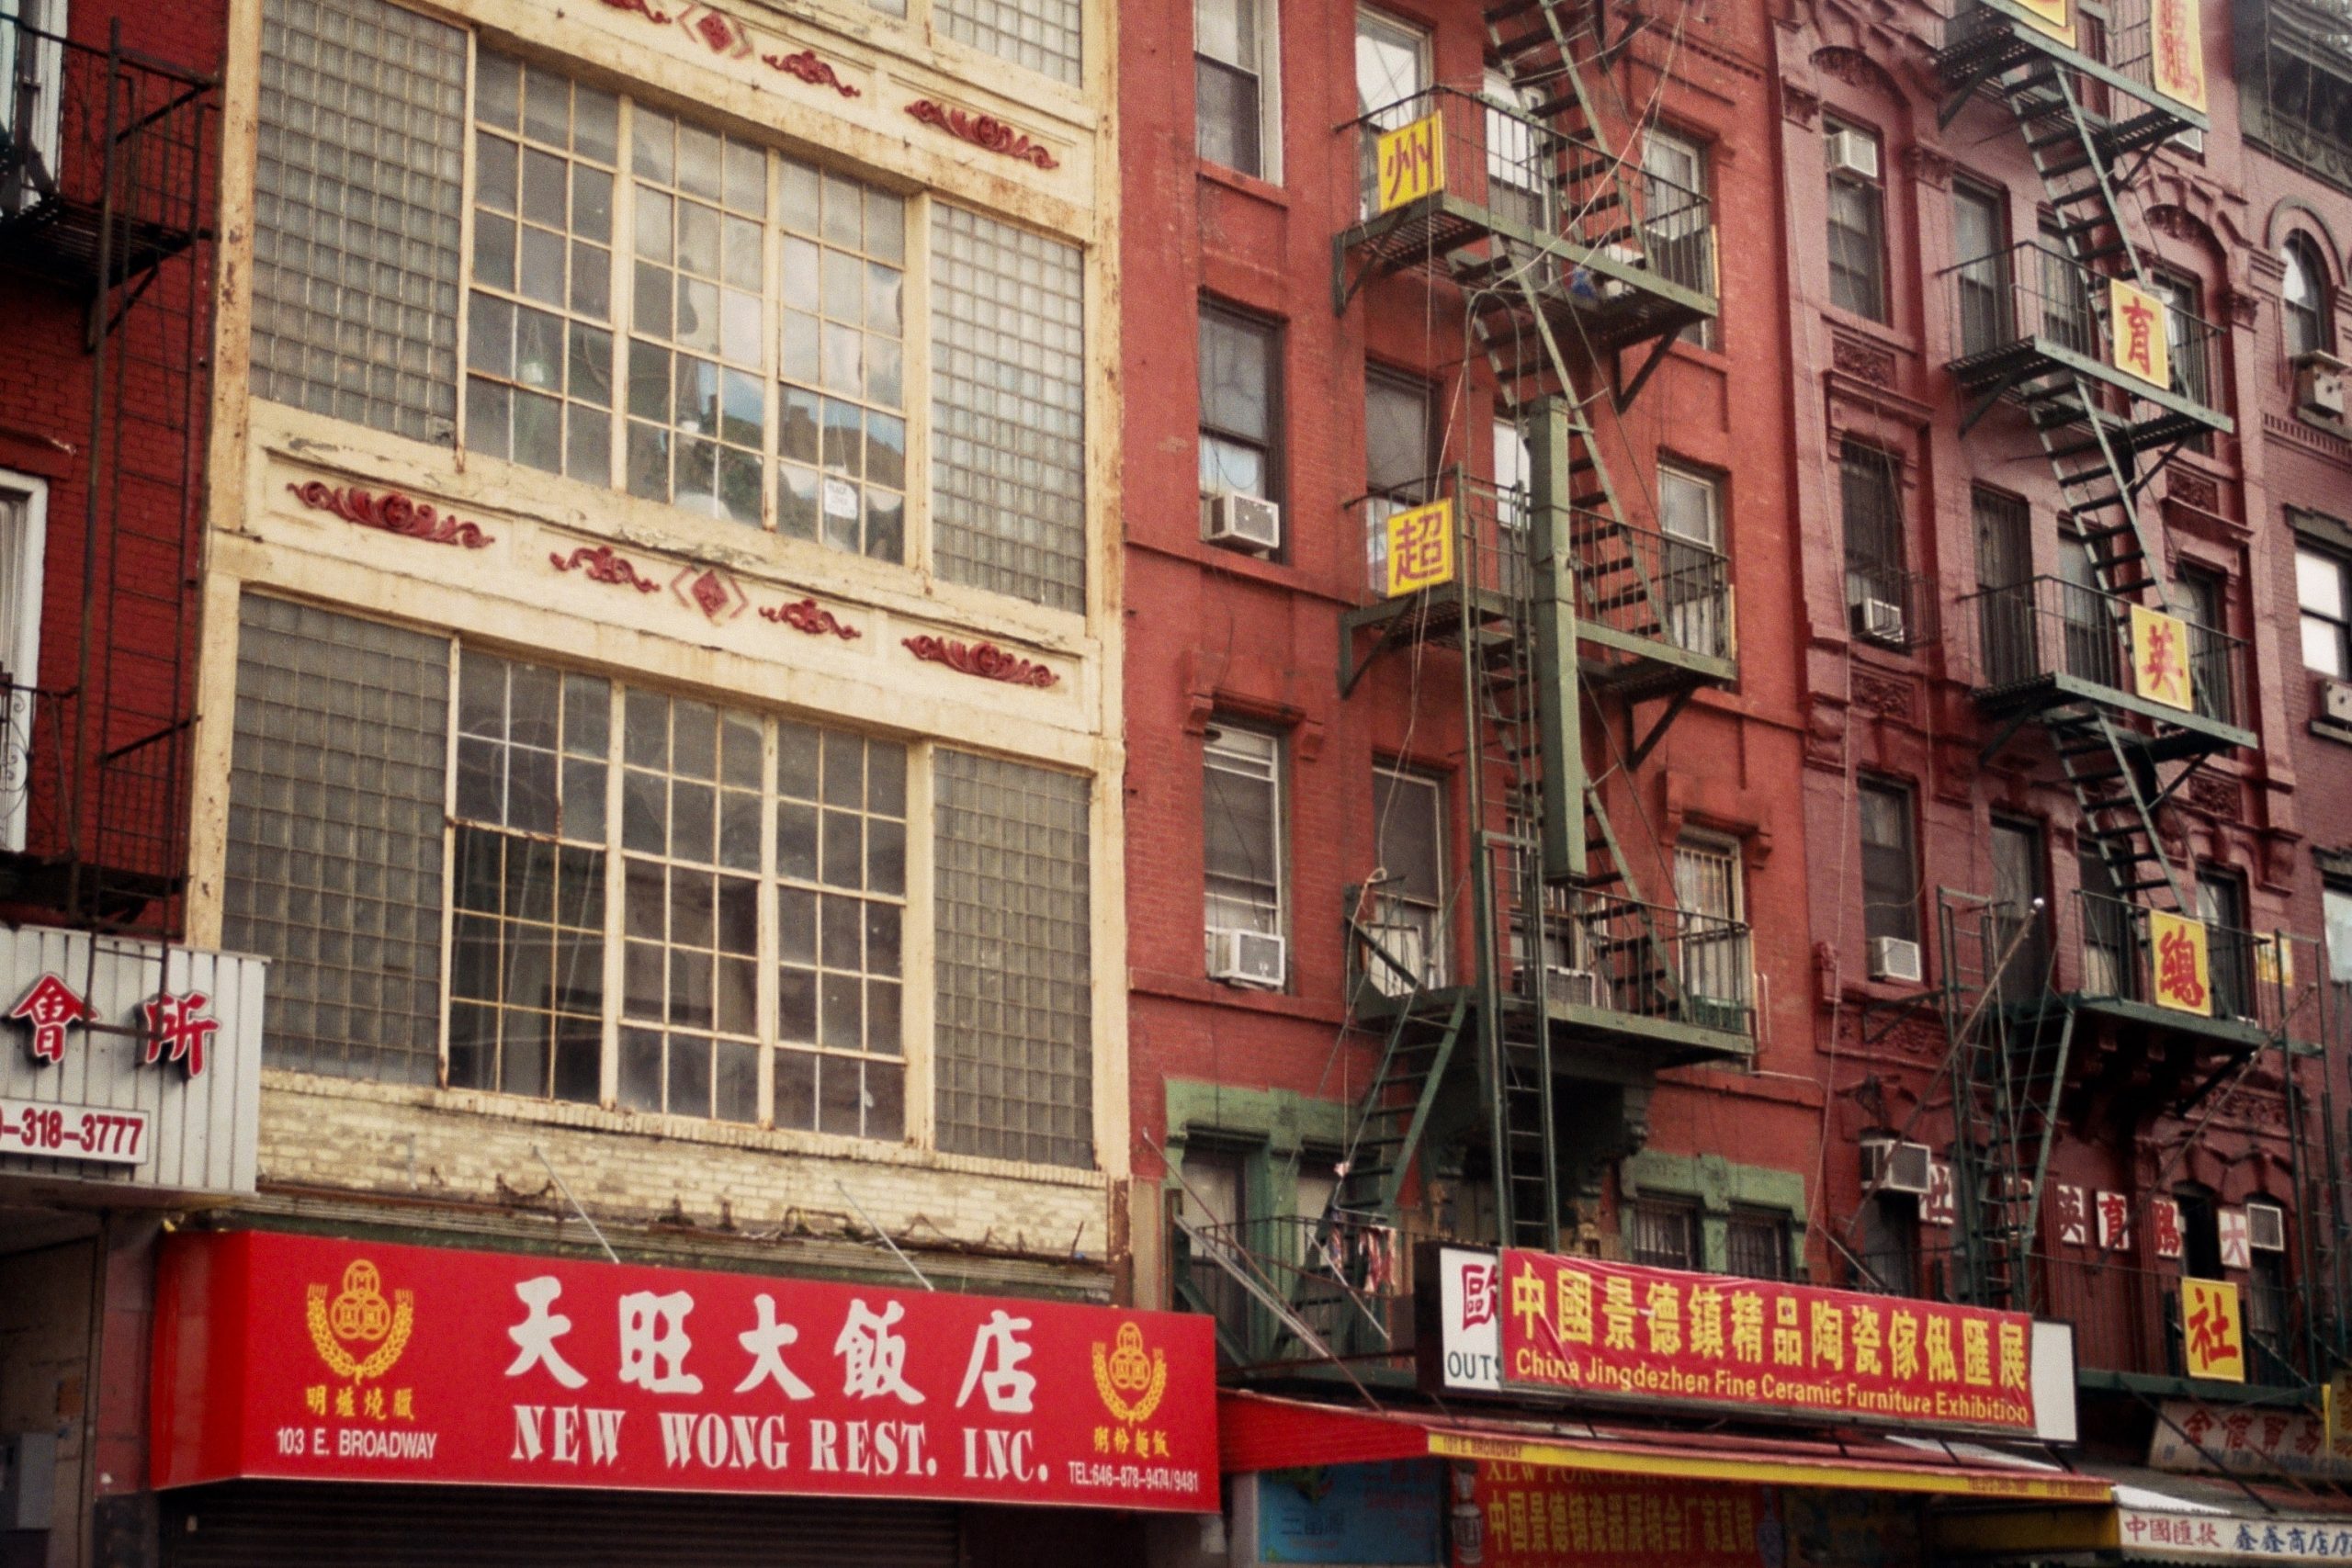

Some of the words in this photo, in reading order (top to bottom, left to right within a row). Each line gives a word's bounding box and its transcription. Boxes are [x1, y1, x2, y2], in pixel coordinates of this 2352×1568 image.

[1386, 121, 1435, 202] 州
[2120, 296, 2155, 376] 育
[1395, 511, 1445, 586] 超
[2140, 620, 2184, 701] 英
[10, 973, 220, 1077] 會所
[0, 1106, 144, 1156] -318-3777
[504, 1276, 1037, 1413] 天旺大飯店
[2188, 1288, 2238, 1371] 社
[1517, 1348, 1579, 1382] China
[1587, 1356, 1709, 1393] Jingdezhen
[1715, 1370, 1756, 1397] Fine
[1762, 1373, 1842, 1404] Ceramic
[1847, 1383, 1931, 1414] Furniture
[1936, 1392, 2029, 1424] Exhibition
[277, 1427, 305, 1455] 103
[313, 1428, 330, 1456] E.
[338, 1428, 437, 1459] BROADWAY
[511, 1404, 627, 1467] NEW
[658, 1412, 789, 1471] WONG
[809, 1419, 937, 1478] REST.
[963, 1427, 1049, 1483] INC.
